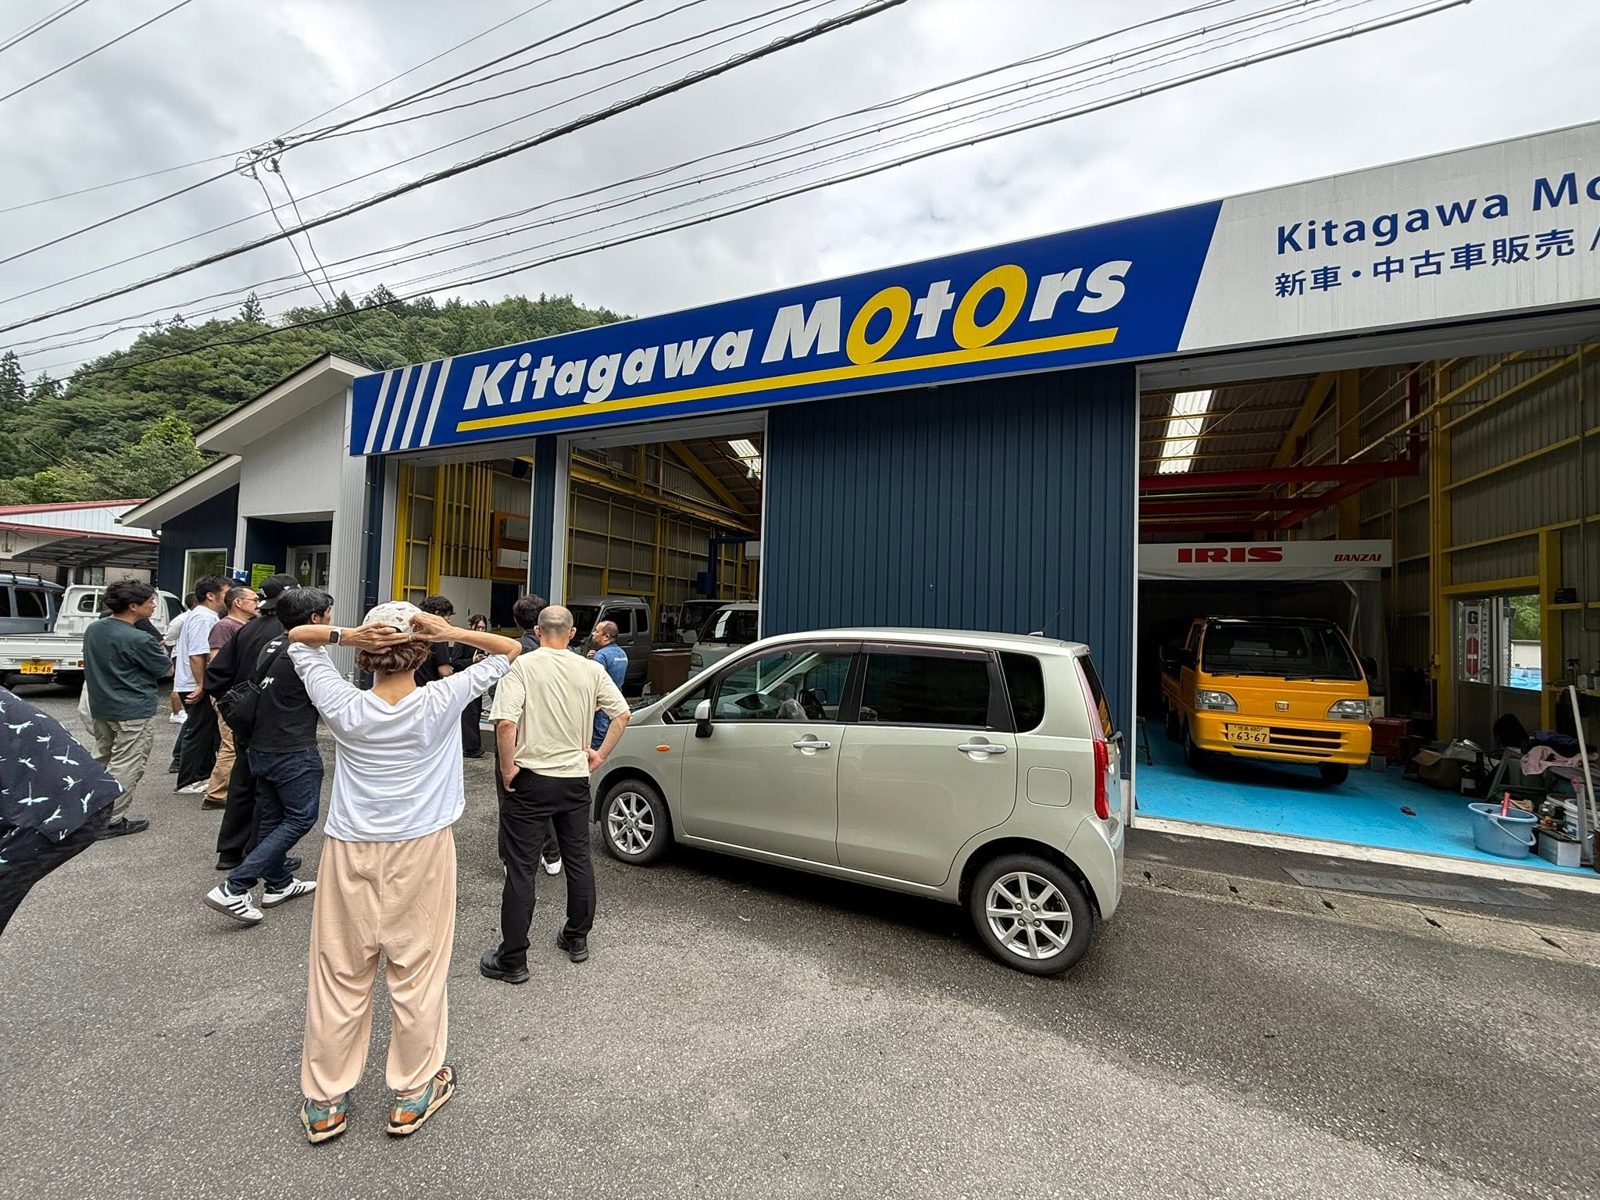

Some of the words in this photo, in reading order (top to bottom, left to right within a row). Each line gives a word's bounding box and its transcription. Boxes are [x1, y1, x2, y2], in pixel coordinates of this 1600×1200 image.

[1276, 192, 1509, 255] Kitagawa
[1275, 228, 1575, 298] 新車・中古車販売
[462, 328, 753, 404] Kitagawa
[1178, 546, 1283, 563] IRIS
[1333, 553, 1382, 562] BANZAI
[1236, 731, 1267, 743] 63-67
